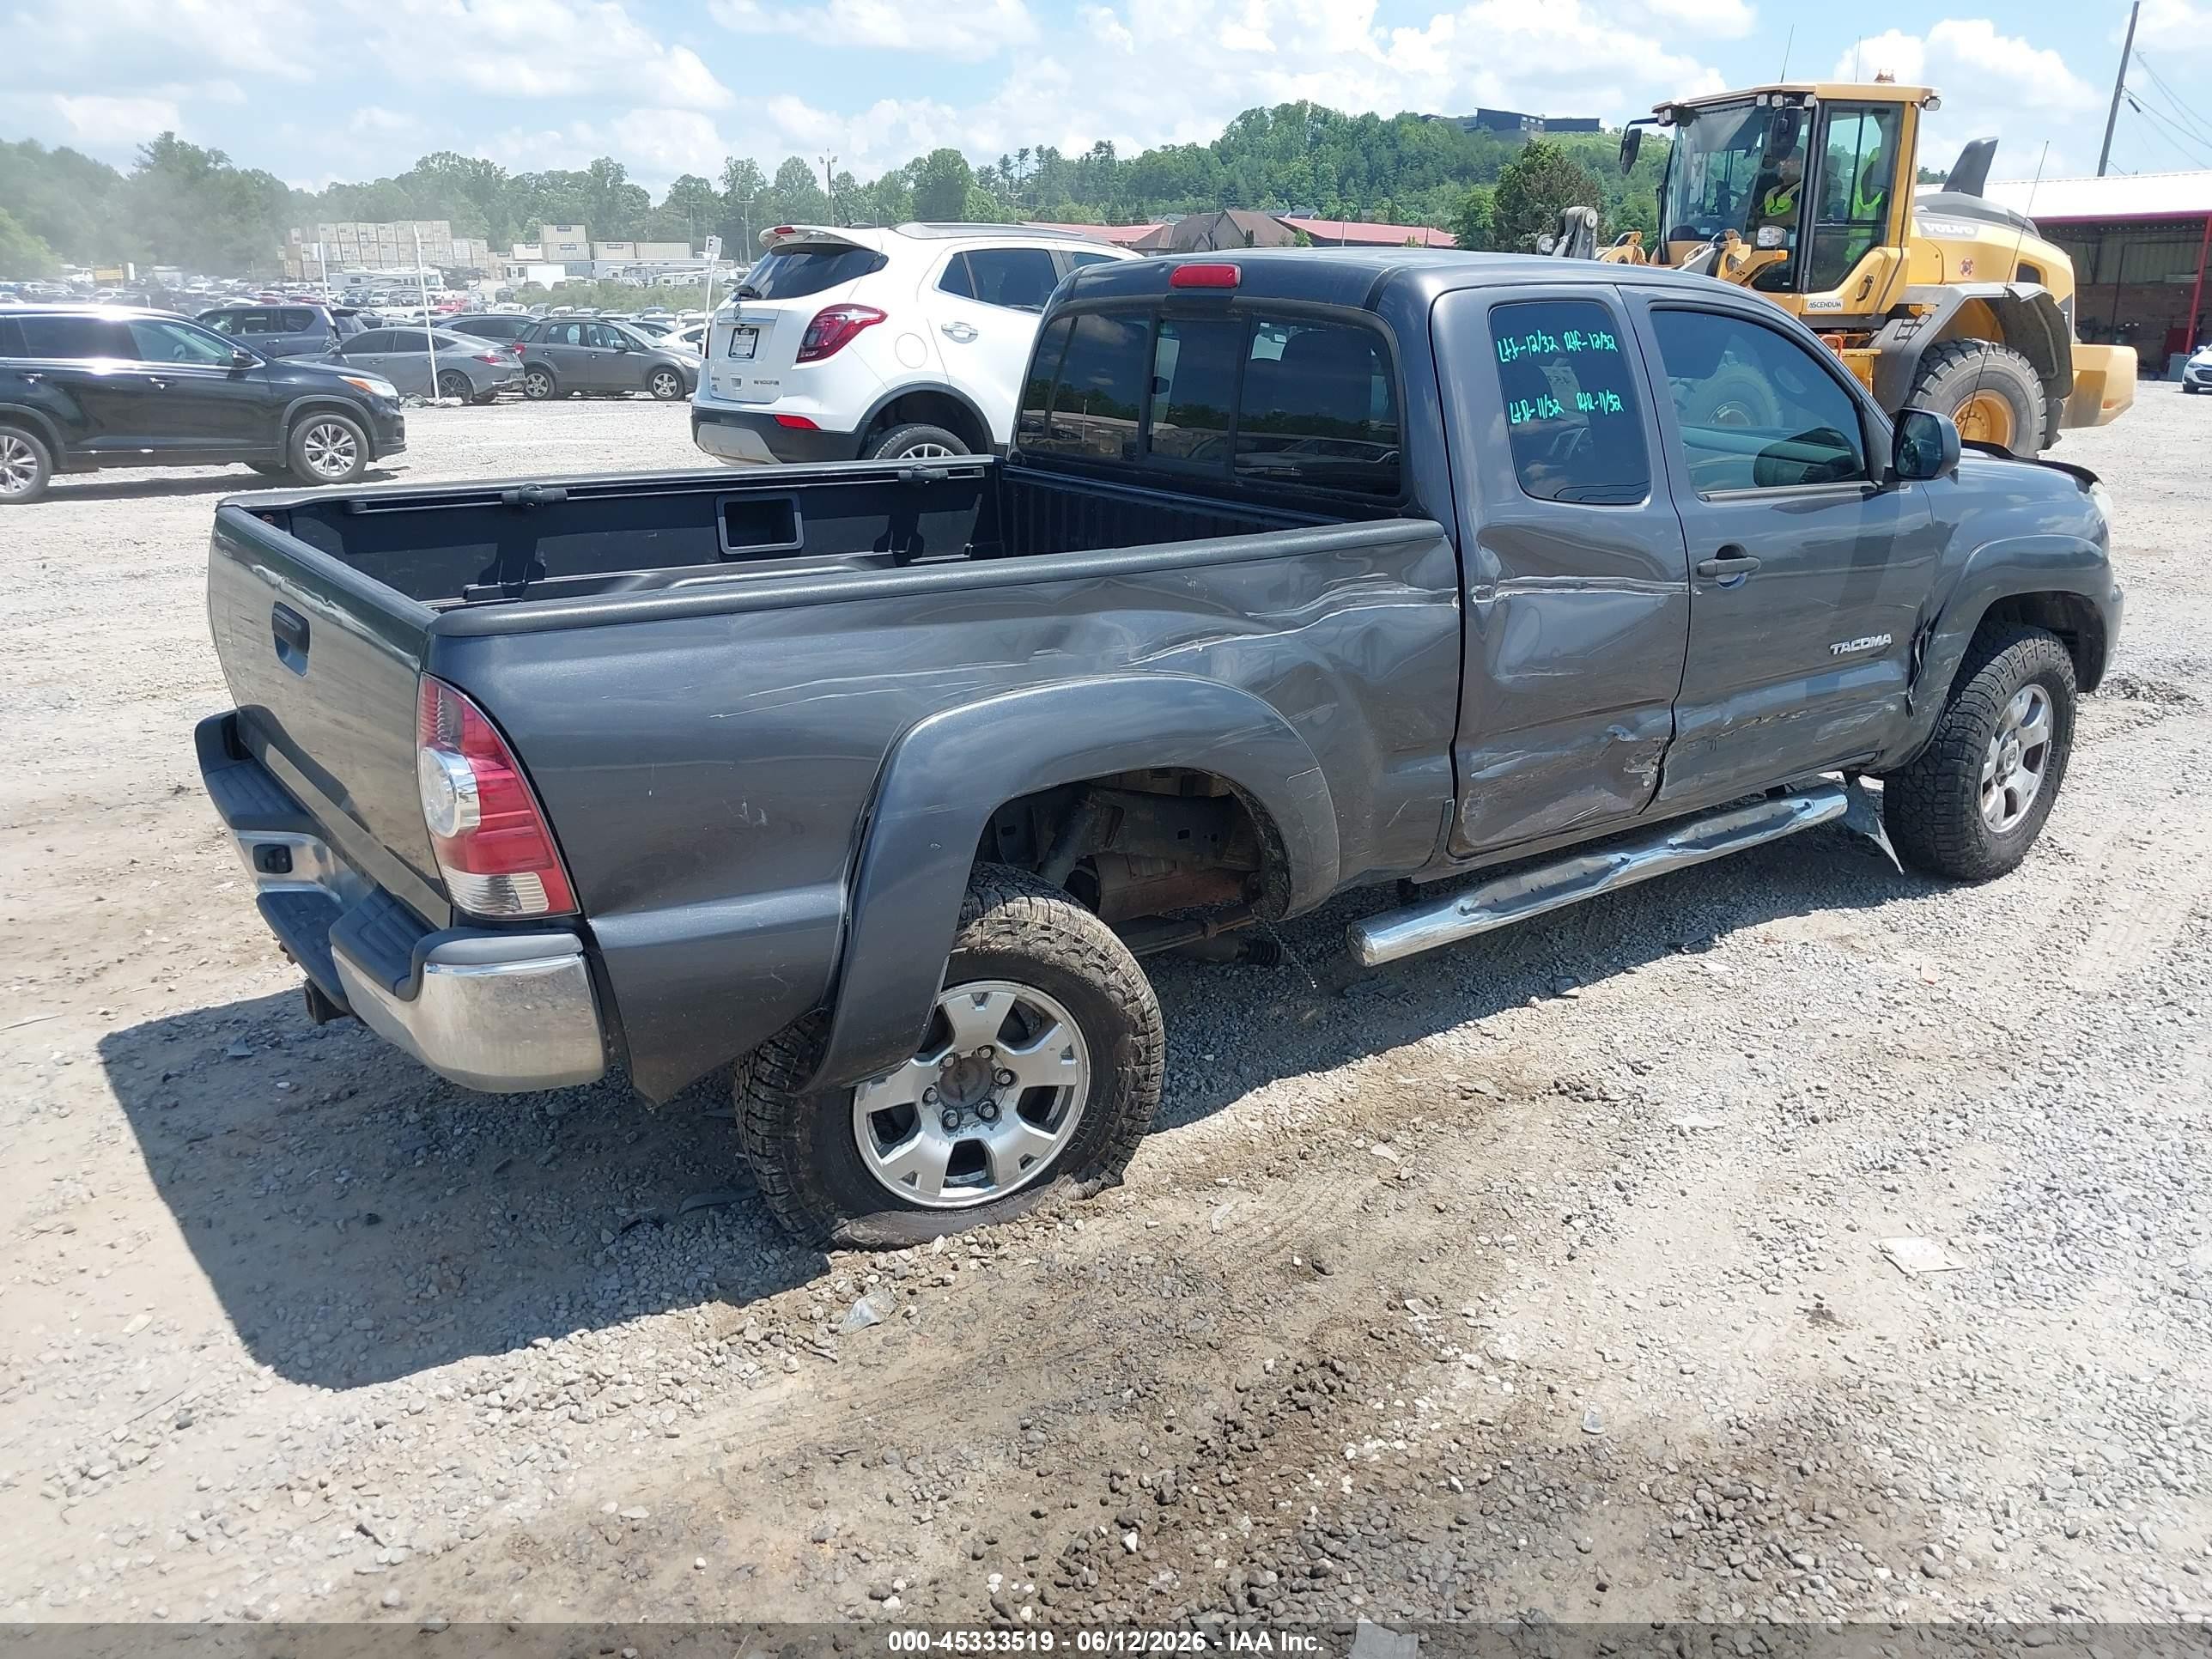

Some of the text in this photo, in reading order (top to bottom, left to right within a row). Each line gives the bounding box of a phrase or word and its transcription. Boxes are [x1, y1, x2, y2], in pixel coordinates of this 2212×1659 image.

[1922, 222, 1975, 234] VOLVO
[1808, 301, 1842, 309] ASCENDUM
[1830, 634, 1893, 655] TACOMA
